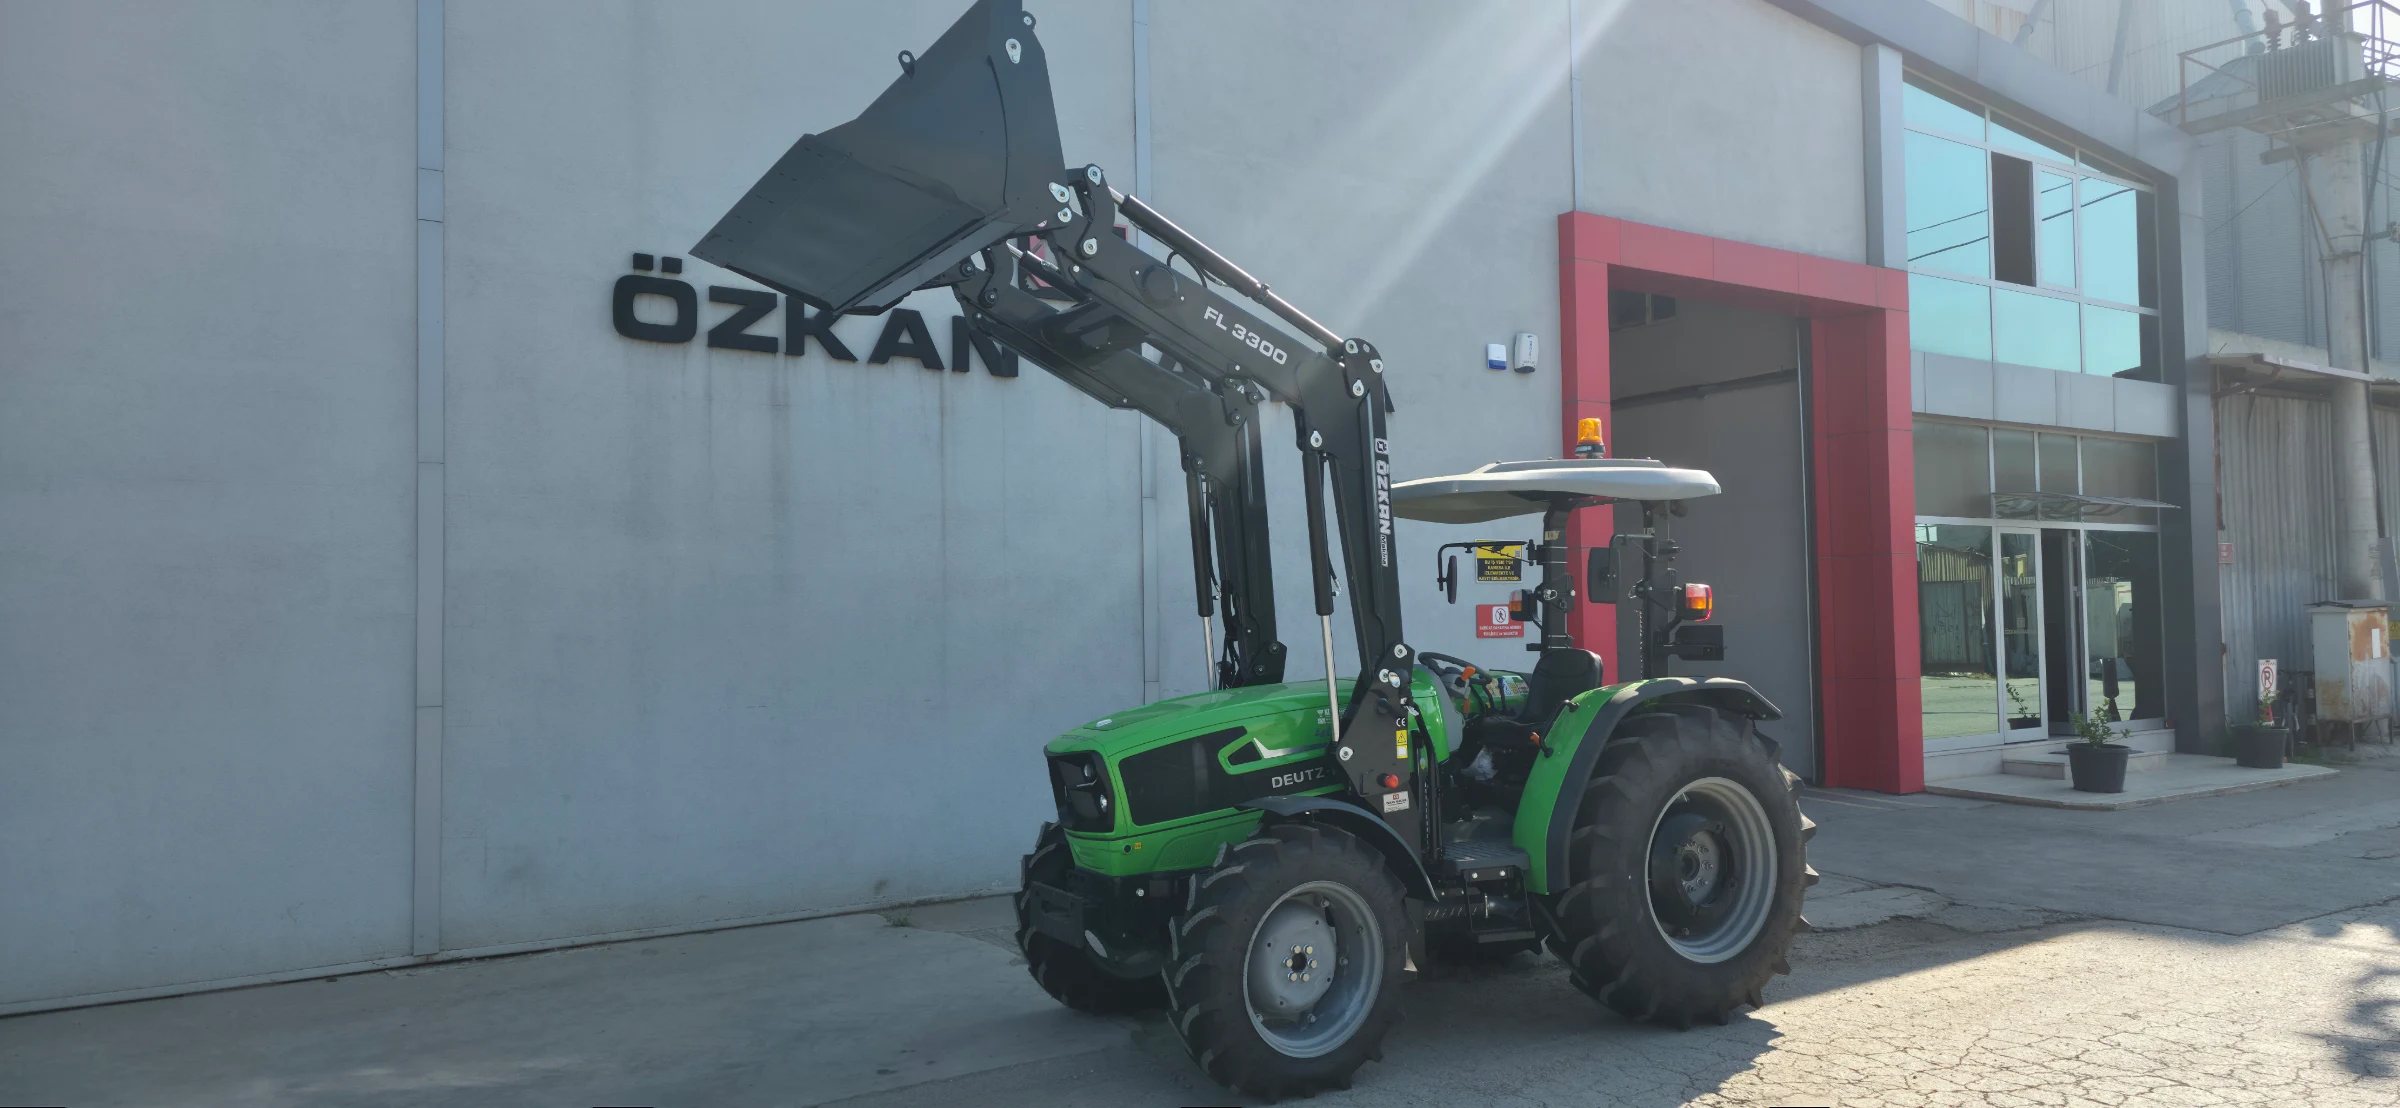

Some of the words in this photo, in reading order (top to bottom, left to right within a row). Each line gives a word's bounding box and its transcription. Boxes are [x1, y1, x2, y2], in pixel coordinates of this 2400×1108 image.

[613, 252, 1019, 378] ÖZKAN
[1203, 305, 1228, 331] FL
[1231, 323, 1288, 365] 3300
[1375, 459, 1391, 535] ÖZKAN
